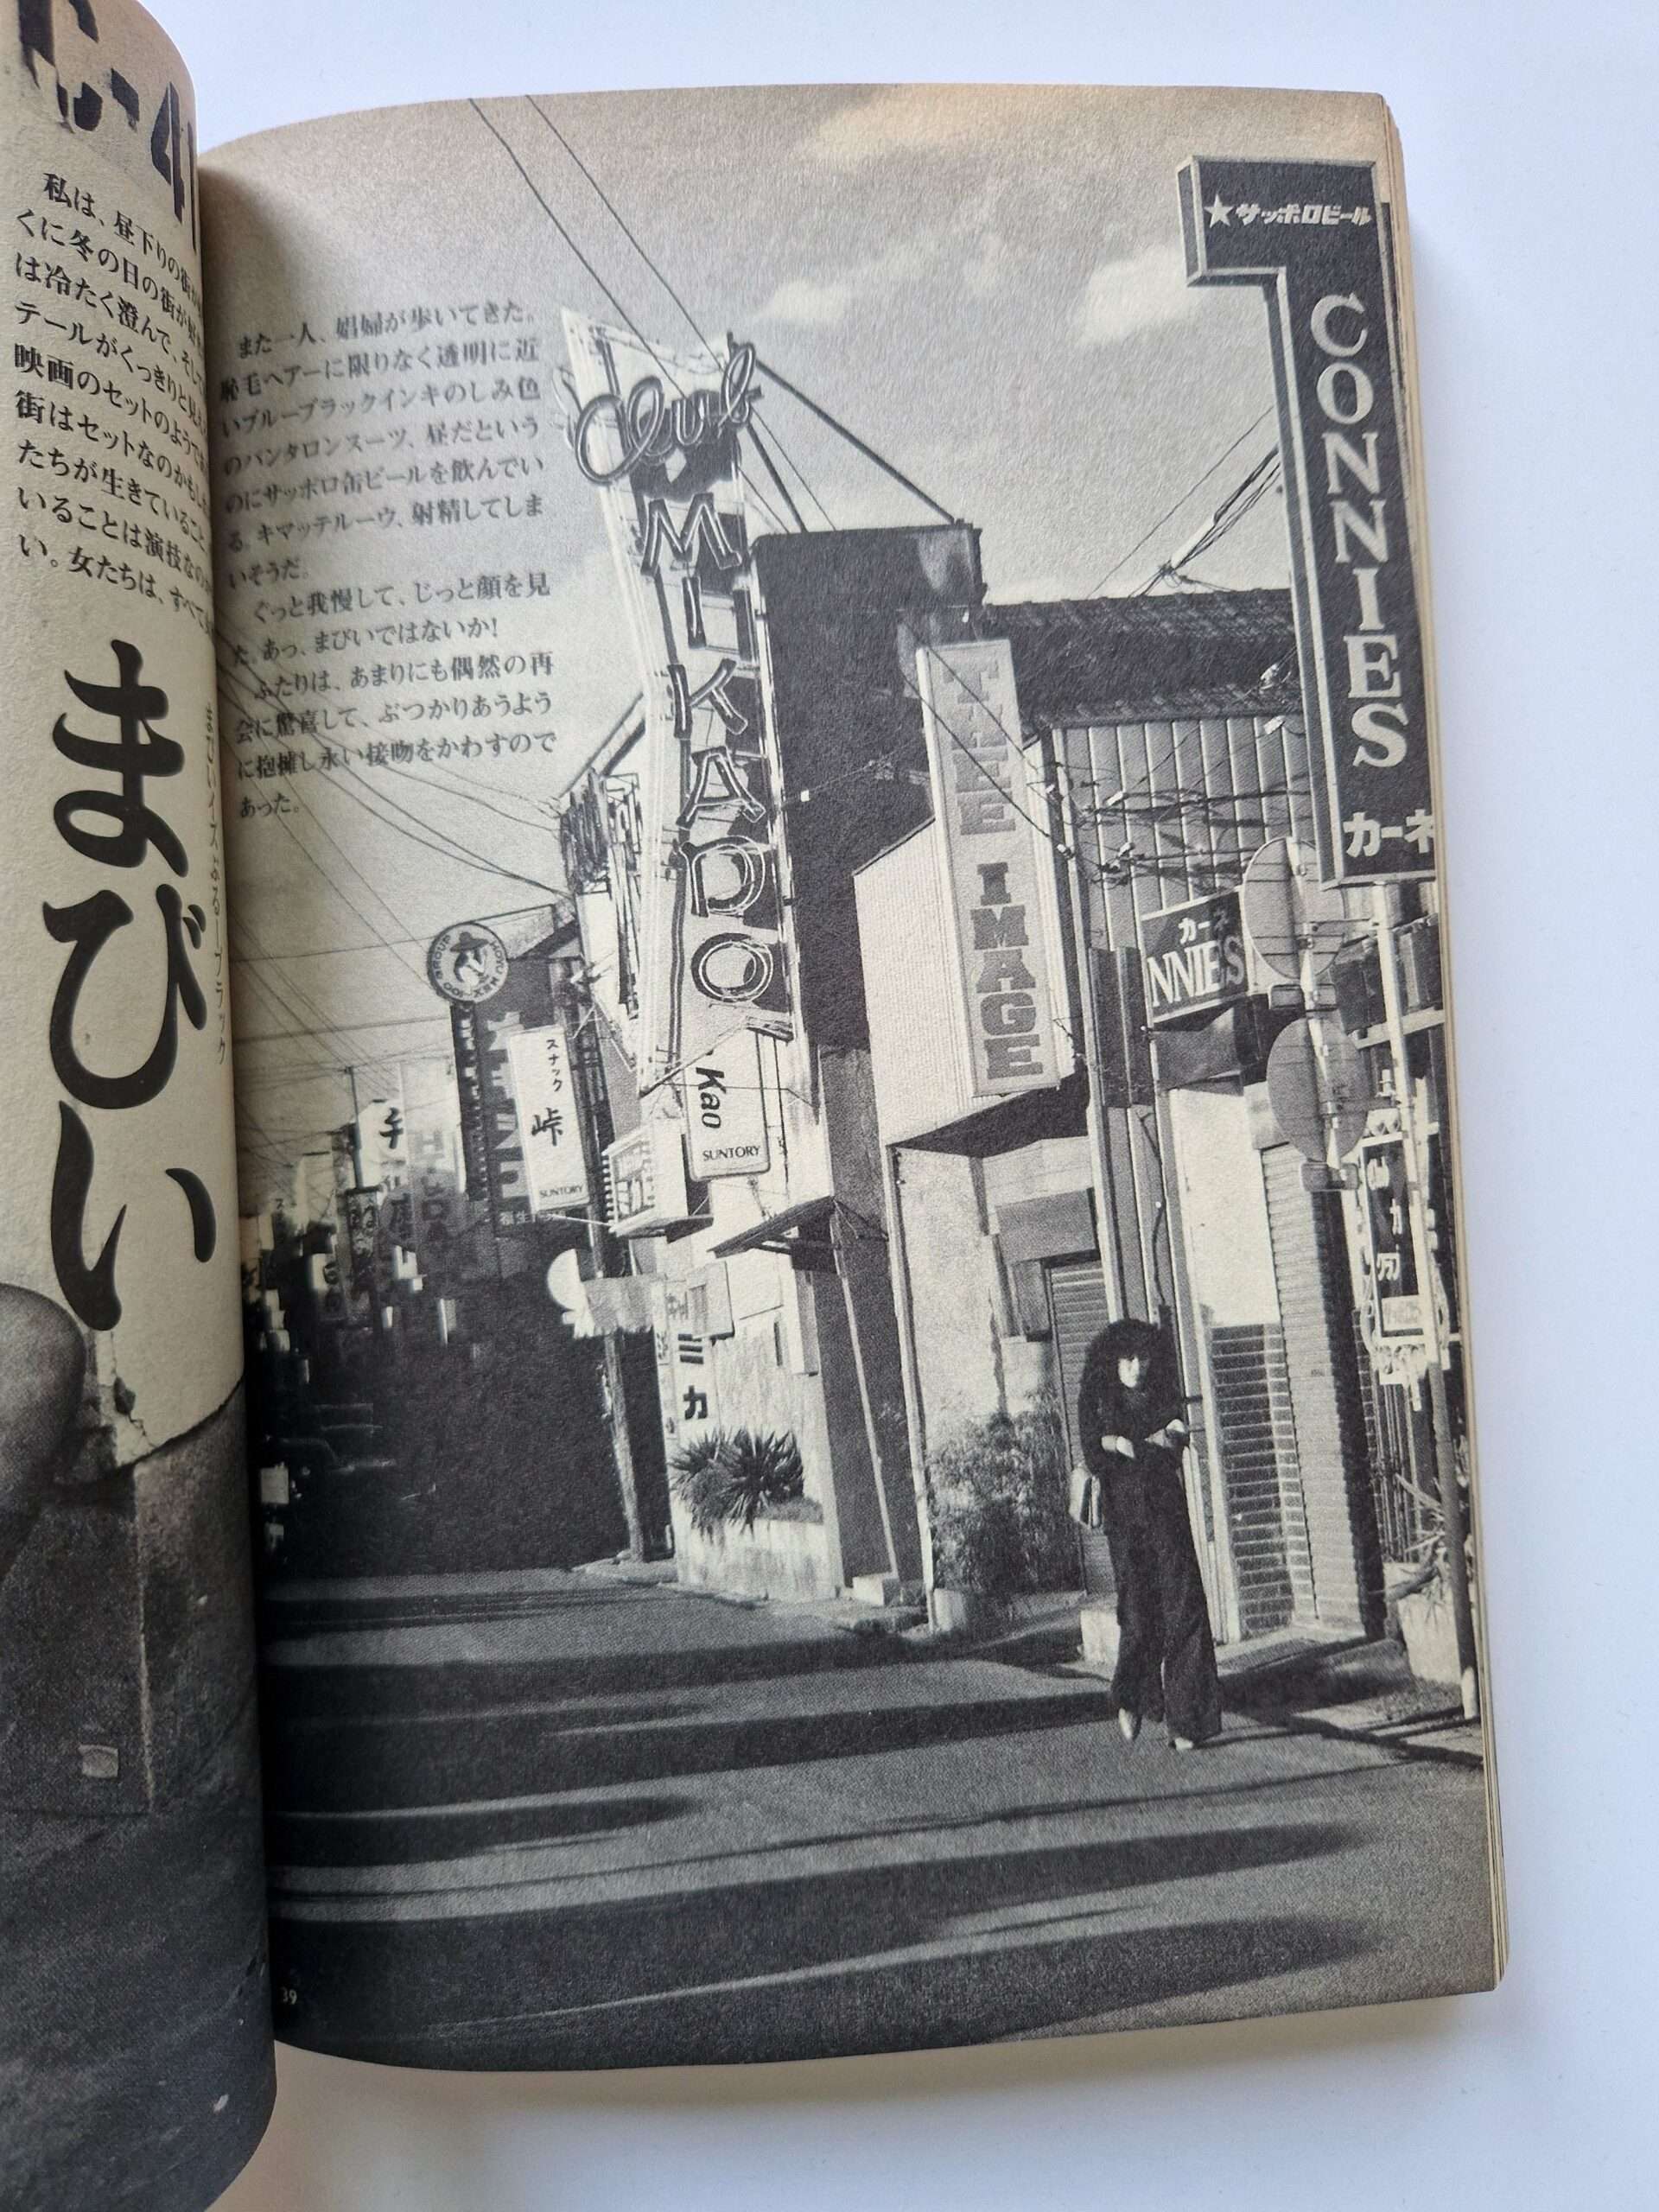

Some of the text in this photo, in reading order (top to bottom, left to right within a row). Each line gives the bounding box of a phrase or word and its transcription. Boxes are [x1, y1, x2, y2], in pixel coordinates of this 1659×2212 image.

[1236, 202, 1373, 226] サッポロビール
[575, 340, 760, 486] Club
[1310, 291, 1410, 768] CONNIES
[639, 492, 774, 1003] MIKADO
[42, 639, 217, 1332] まびい
[969, 861, 1044, 1080] IMAGE
[546, 1039, 563, 1093] スナック
[531, 1107, 564, 1147] 峠
[695, 1067, 727, 1129] Kao
[702, 1145, 761, 1162] SUNTORY
[539, 1184, 584, 1199] SUNTORY
[280, 1986, 297, 2005] 39
